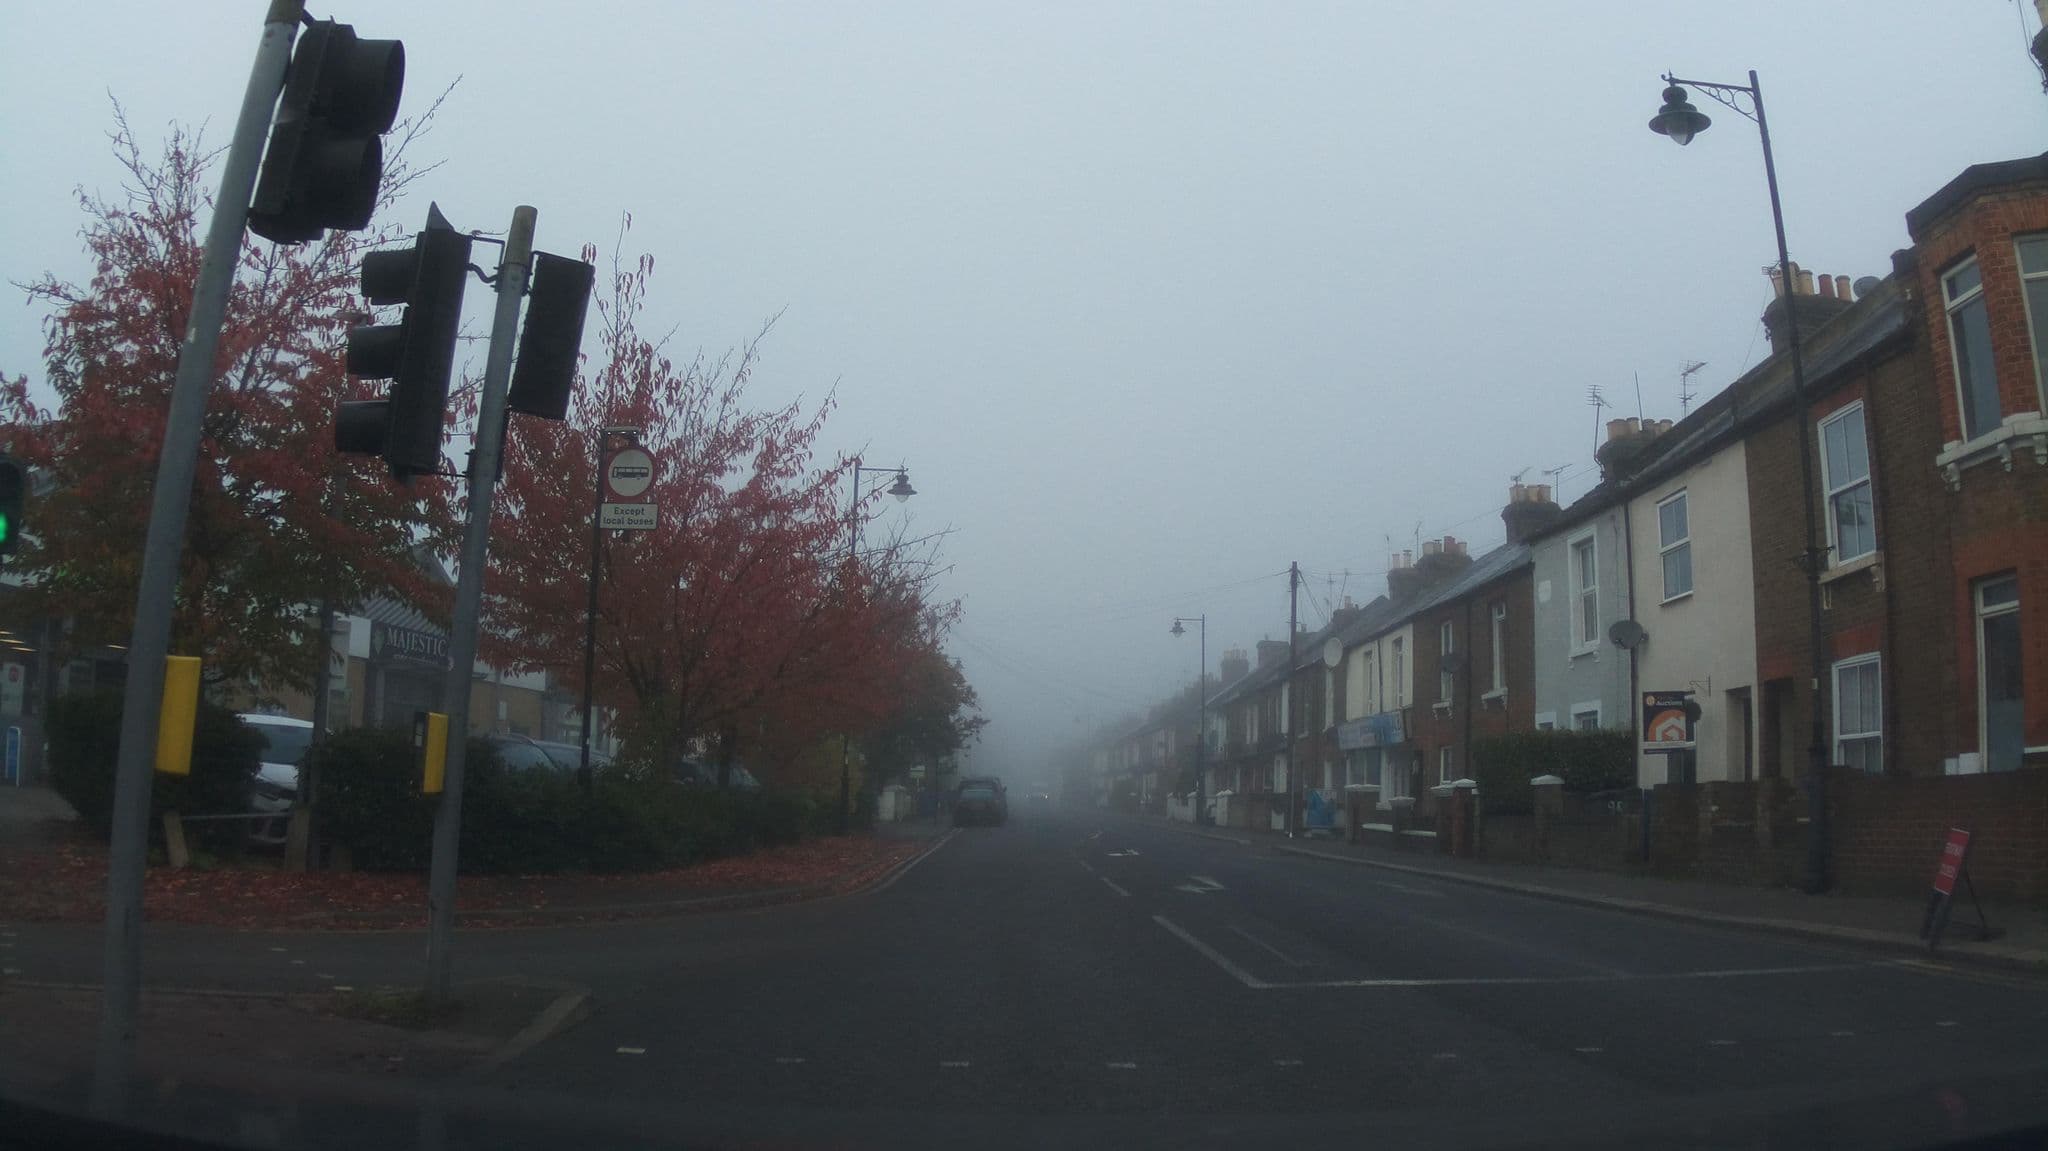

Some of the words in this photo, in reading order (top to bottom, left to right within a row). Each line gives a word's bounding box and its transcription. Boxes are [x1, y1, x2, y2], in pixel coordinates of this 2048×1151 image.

[614, 507, 645, 516] Except
[603, 516, 625, 525] local
[627, 517, 654, 526] buses
[385, 627, 447, 657] MAJESTIC
